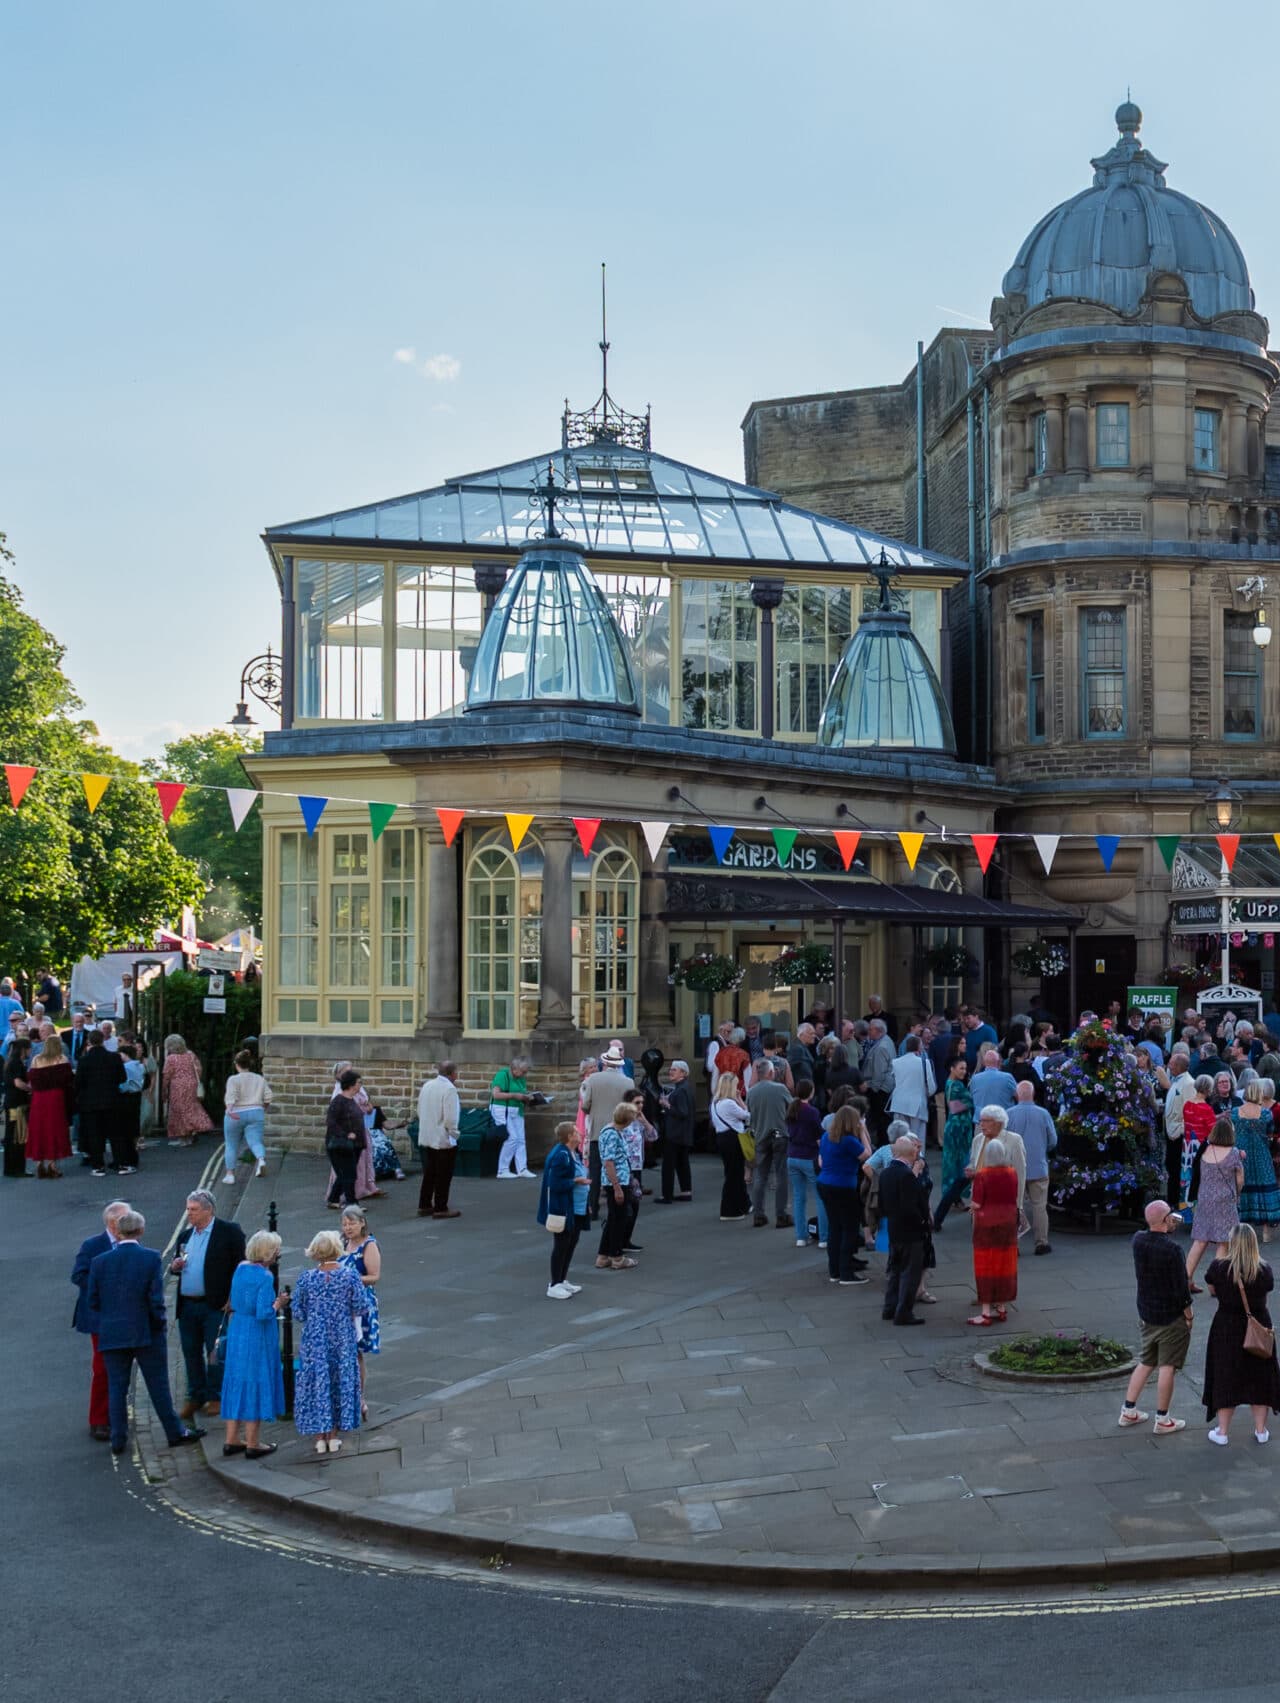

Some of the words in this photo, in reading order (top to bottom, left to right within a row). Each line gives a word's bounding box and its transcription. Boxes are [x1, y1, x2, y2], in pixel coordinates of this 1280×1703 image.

[1179, 905, 1197, 920] OPERA
[1198, 903, 1217, 919] HOUSE
[1132, 994, 1172, 1006] RAFFLE
